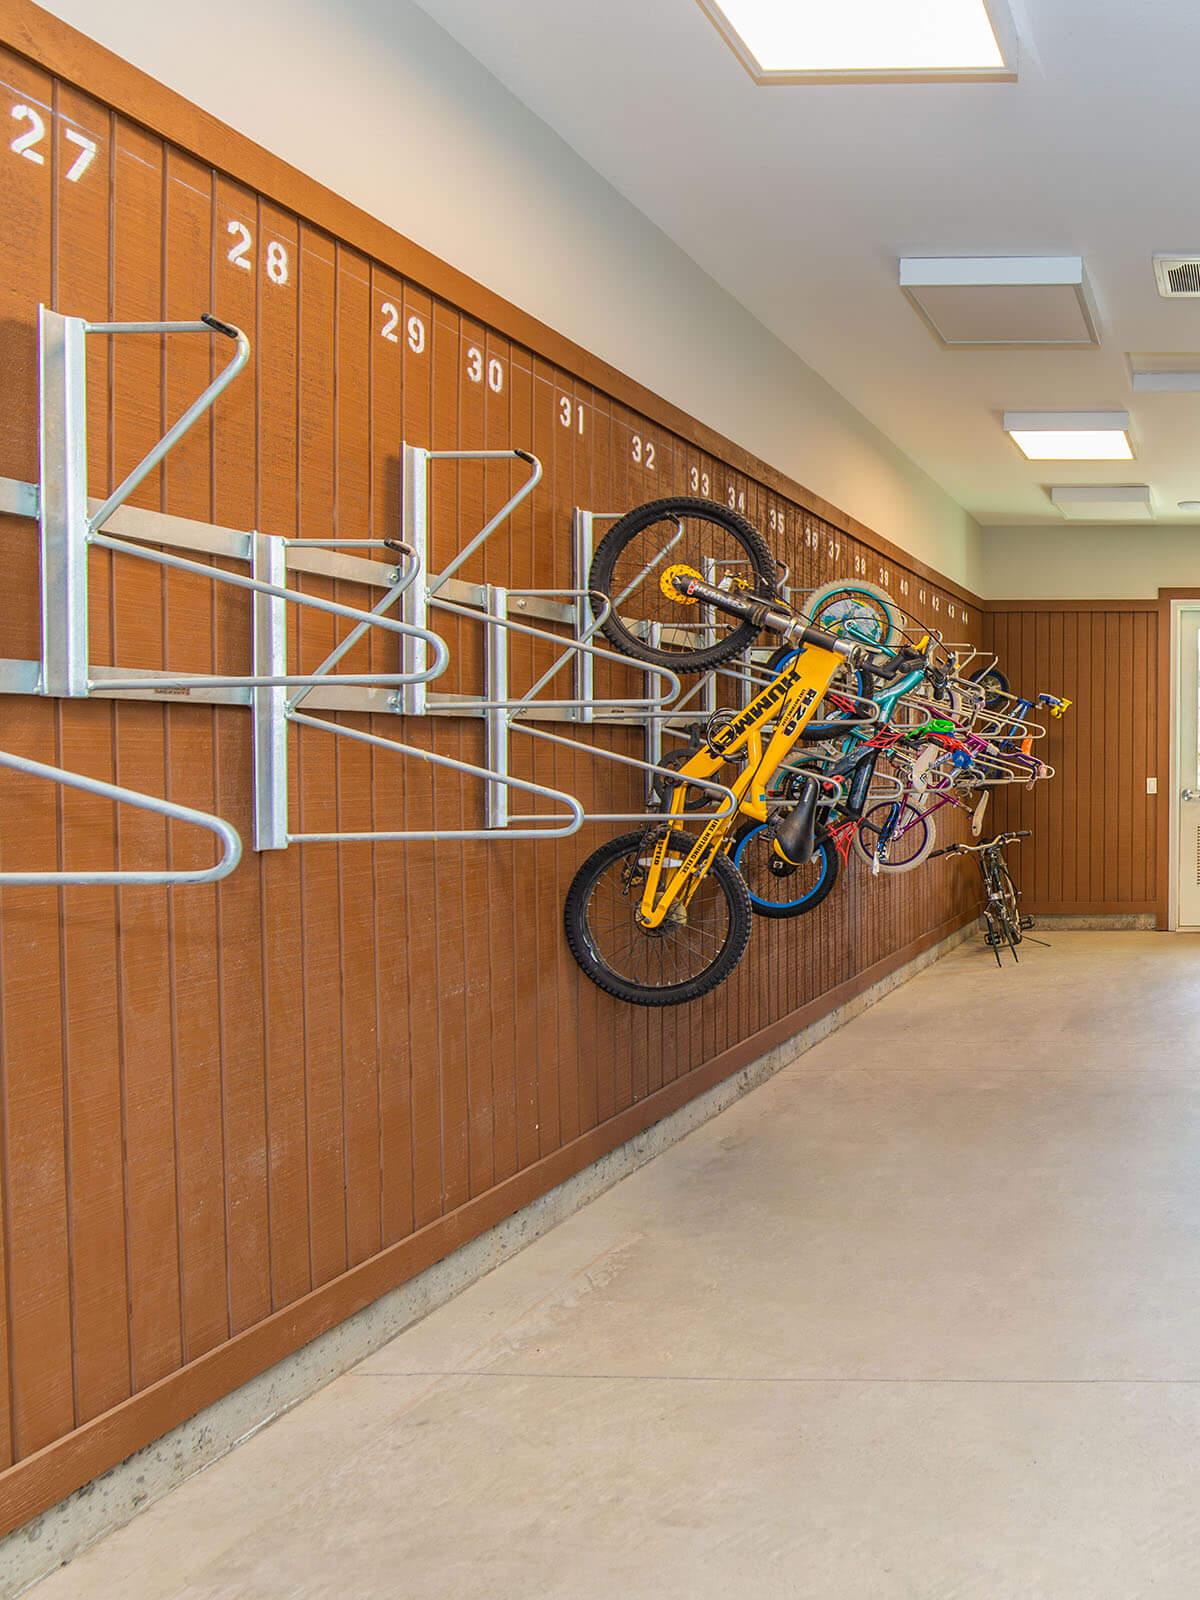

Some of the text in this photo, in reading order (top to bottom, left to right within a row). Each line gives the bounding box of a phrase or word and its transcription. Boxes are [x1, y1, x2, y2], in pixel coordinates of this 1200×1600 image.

[11, 104, 96, 182] 27
[227, 221, 289, 285] 28
[380, 302, 425, 353] 29
[467, 347, 503, 392] 30
[560, 396, 583, 434] 31
[632, 435, 655, 469] 32
[691, 467, 709, 496] 33
[728, 487, 745, 515] 34
[770, 509, 784, 534] 35
[829, 540, 840, 561] 37
[855, 556, 866, 575] 38
[704, 670, 801, 759] HUMMER
[691, 831, 711, 858] NOTHING
[682, 859, 692, 873] ELSE
